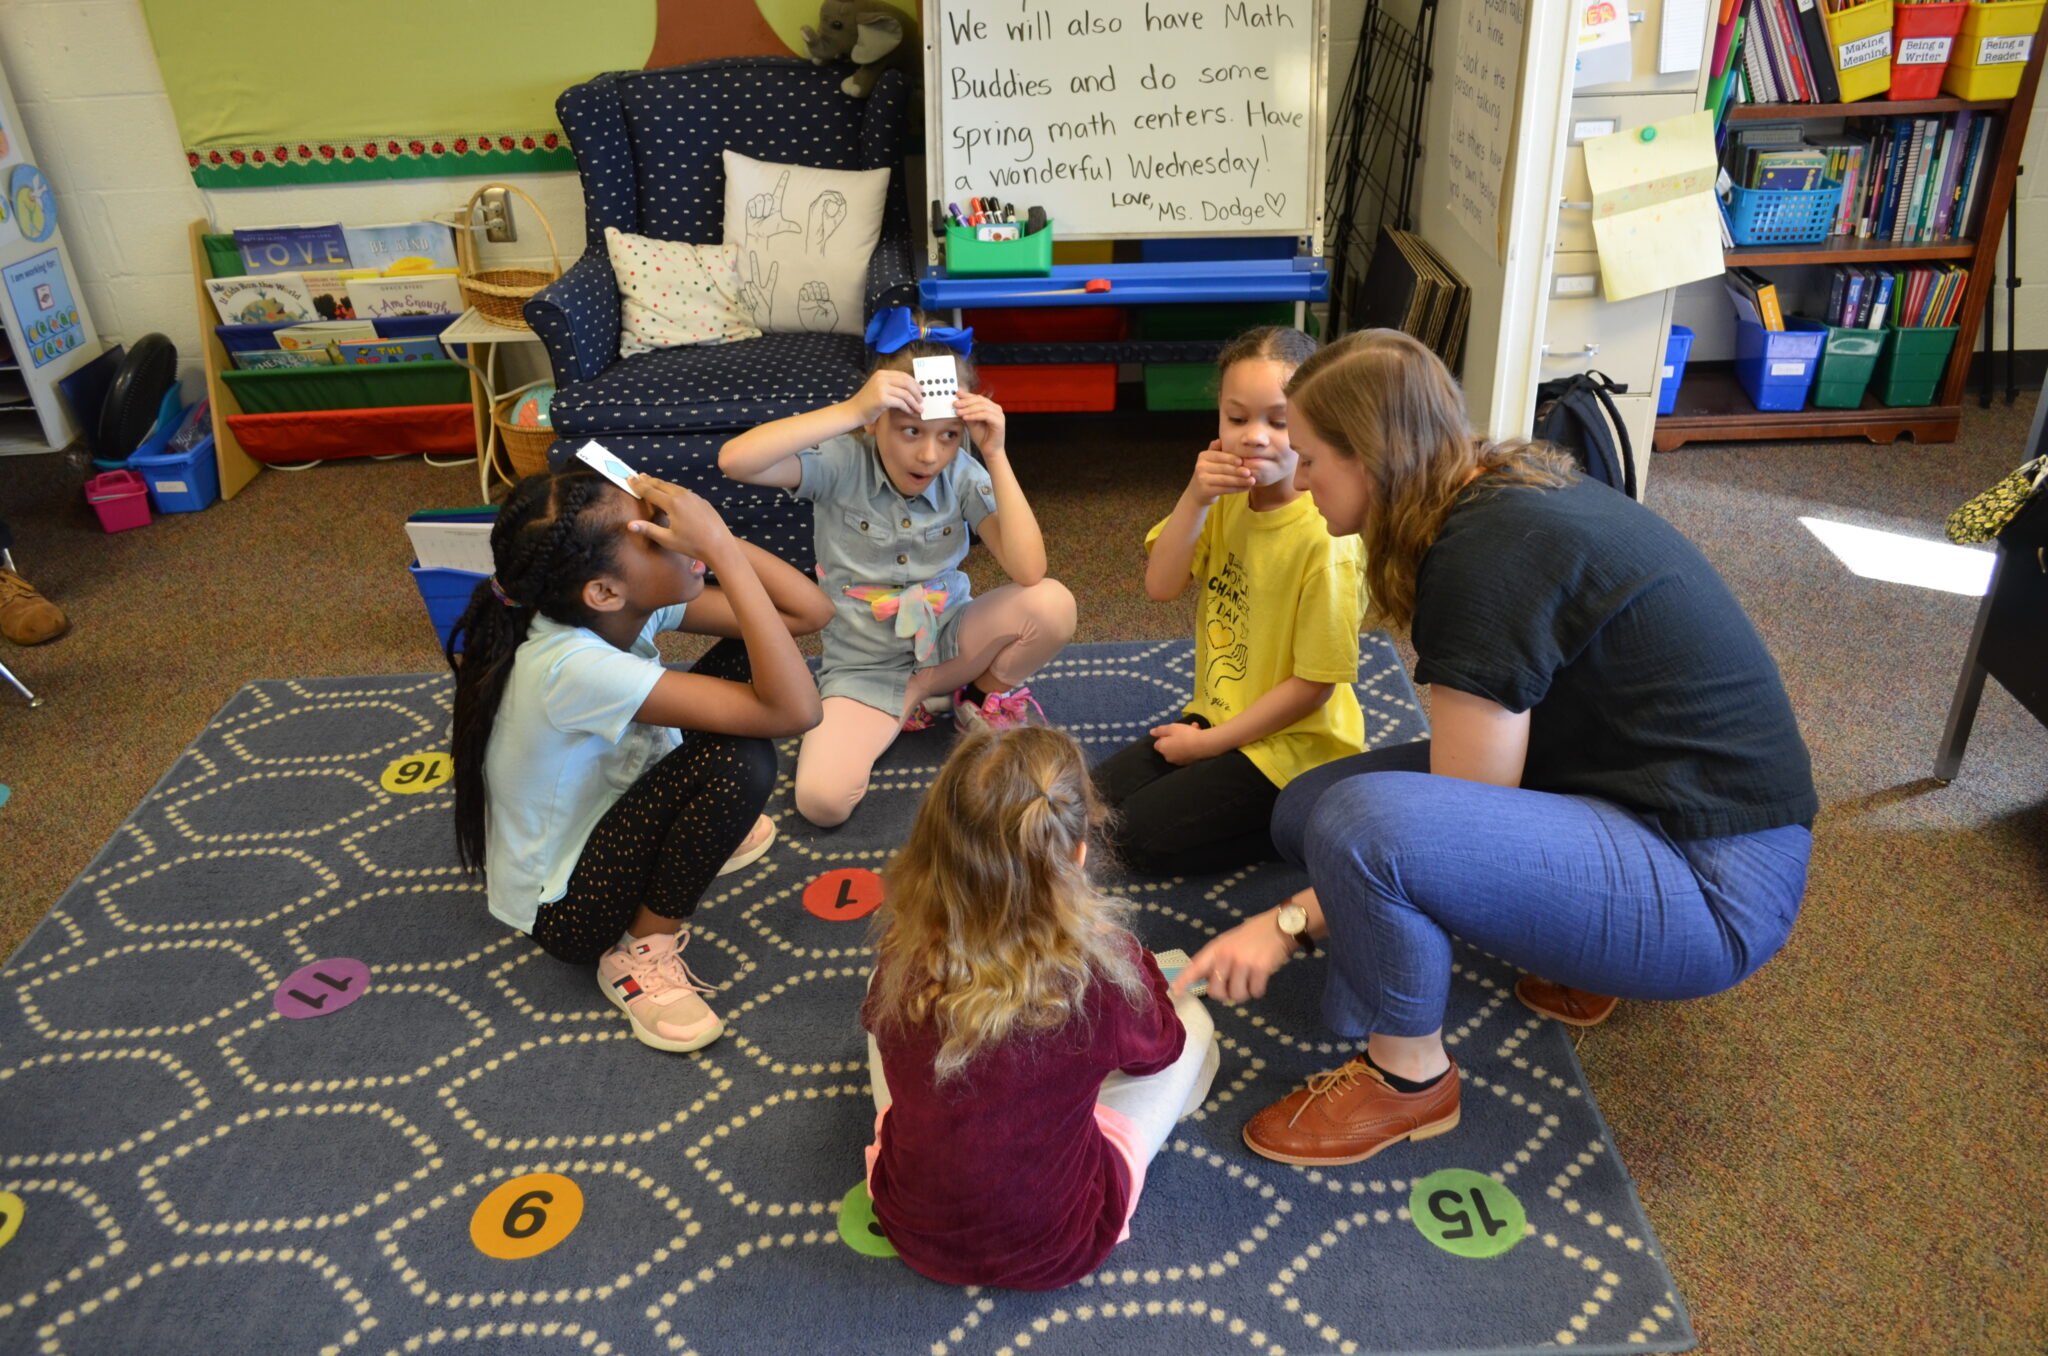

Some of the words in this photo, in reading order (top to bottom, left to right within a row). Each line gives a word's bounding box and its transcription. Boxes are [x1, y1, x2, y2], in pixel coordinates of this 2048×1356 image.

[948, 9, 987, 45] We
[1006, 10, 1051, 42] will
[1067, 9, 1122, 36] also
[1145, 2, 1203, 31] have
[1225, 1, 1294, 29] Math
[1843, 46, 1888, 67] Meaning
[1845, 35, 1885, 55] Making
[1906, 40, 1935, 51] Being
[1937, 42, 1945, 50] a
[1984, 51, 2021, 62] Reader
[1985, 39, 2015, 51] Being
[2016, 40, 2025, 48] a
[1905, 52, 1942, 62] Writer
[951, 66, 1053, 100] Buddies
[1070, 64, 1116, 94] and
[1140, 63, 1176, 90] do
[1198, 65, 1269, 84] some
[1048, 111, 1117, 143] math
[1134, 104, 1234, 130] centers.
[1246, 99, 1304, 128] Have
[954, 175, 973, 190] a
[989, 154, 1112, 187] wonderful
[1128, 134, 1272, 189] Wednesday!
[1111, 192, 1154, 211] Love,
[1158, 201, 1193, 222] Ms.
[1201, 197, 1266, 226] Dodge
[242, 239, 345, 269] LOVE
[395, 239, 430, 252] KIND
[258, 281, 274, 290] the
[275, 282, 302, 300] World
[404, 294, 452, 315] Enough
[1216, 602, 1239, 624] DAY
[394, 760, 441, 784] 16
[835, 878, 858, 909] 1
[288, 972, 353, 1010] 11
[1427, 1187, 1508, 1240] 15
